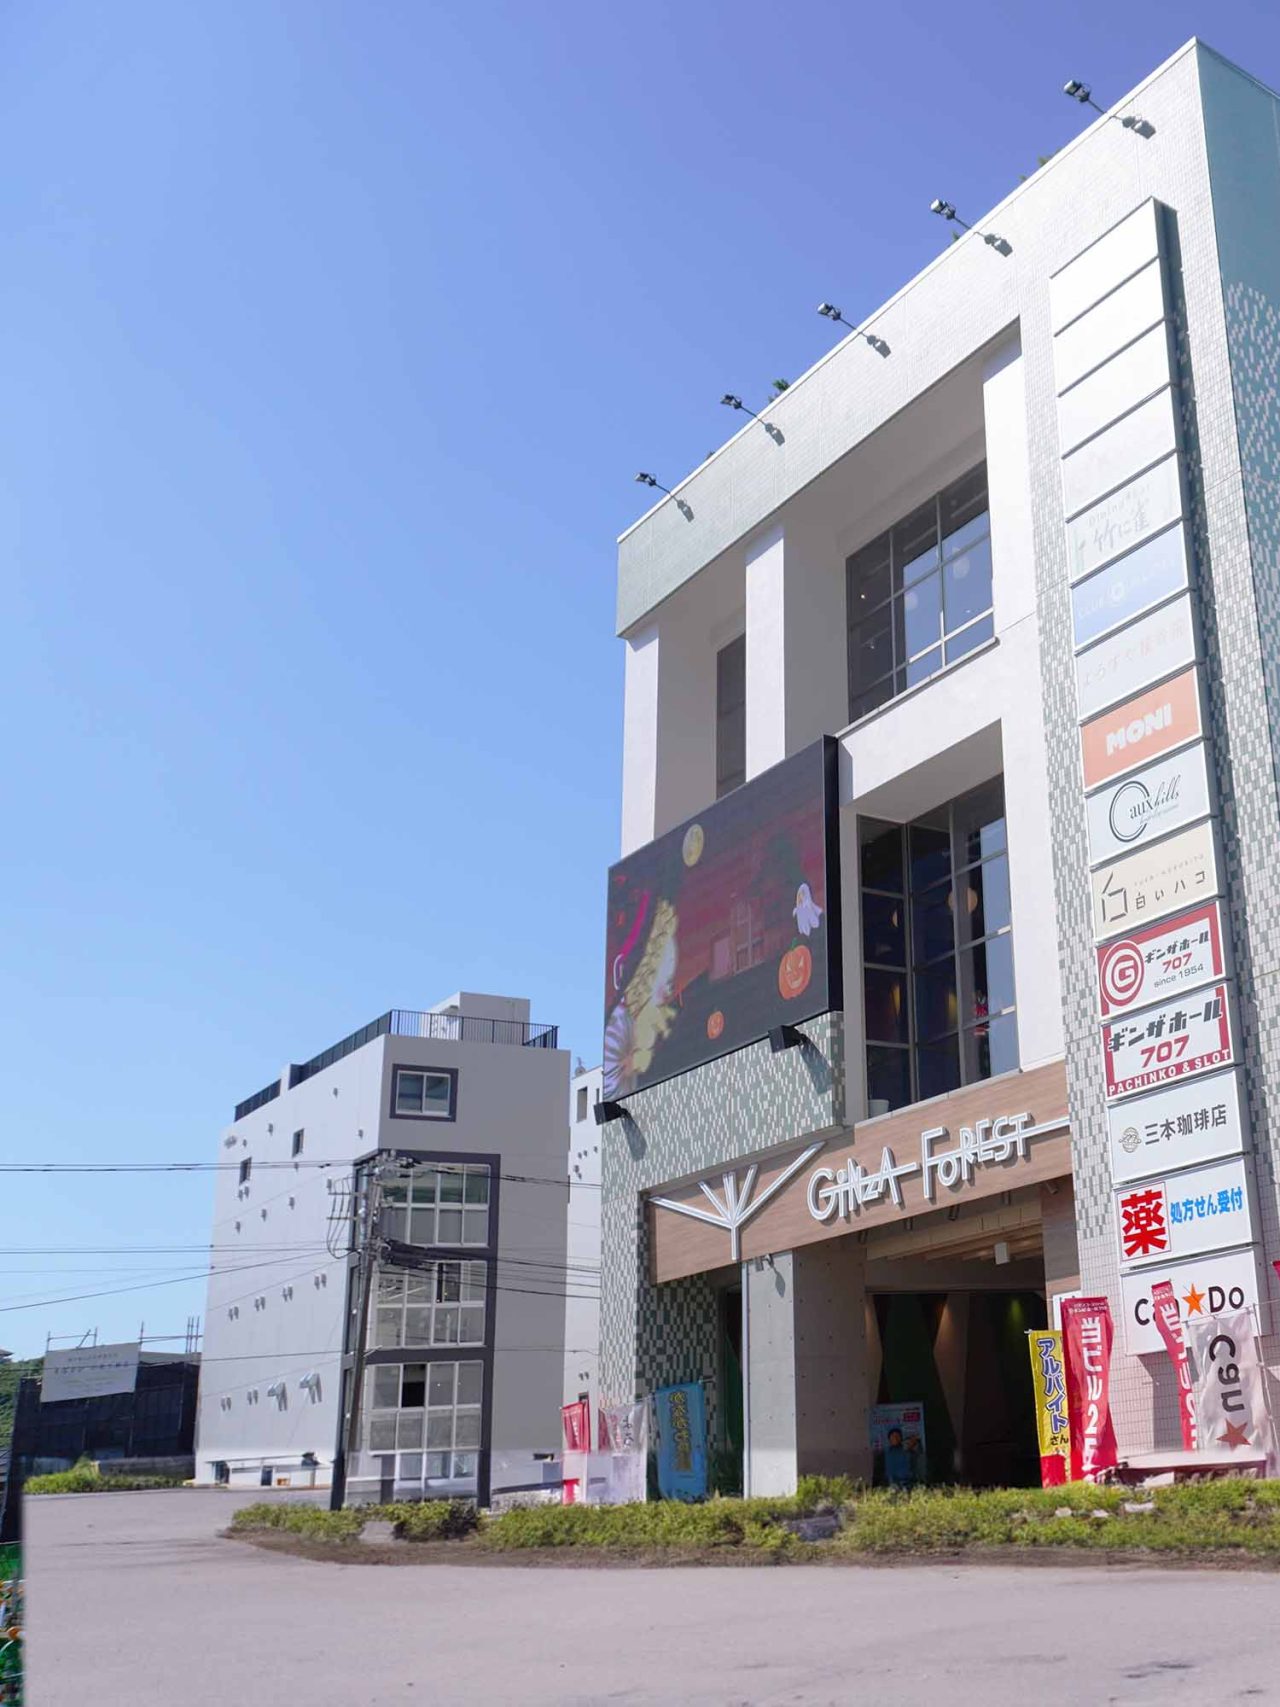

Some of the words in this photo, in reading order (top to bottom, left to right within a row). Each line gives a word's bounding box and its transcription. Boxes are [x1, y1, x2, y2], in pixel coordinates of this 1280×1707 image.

[1105, 704, 1172, 757] MONI
[1136, 871, 1206, 909] 白いハコ
[1145, 931, 1209, 964] ギンザホール
[1162, 953, 1192, 973] 707
[1153, 974, 1177, 988] since
[1179, 963, 1204, 981] 1954
[1108, 999, 1222, 1053] ギンザホール
[1140, 1035, 1190, 1068] 707
[1109, 1064, 1177, 1096] PACHINKO
[1182, 1061, 1191, 1074] &
[1194, 1048, 1230, 1070] SLOT
[1144, 1104, 1227, 1146] 三本珈琲店
[1121, 1190, 1167, 1257] 薬
[1170, 1187, 1243, 1224] 処方せん受付
[1209, 1286, 1244, 1313] Do
[1036, 1338, 1069, 1435] アルバイト
[1050, 1434, 1069, 1446] さん
